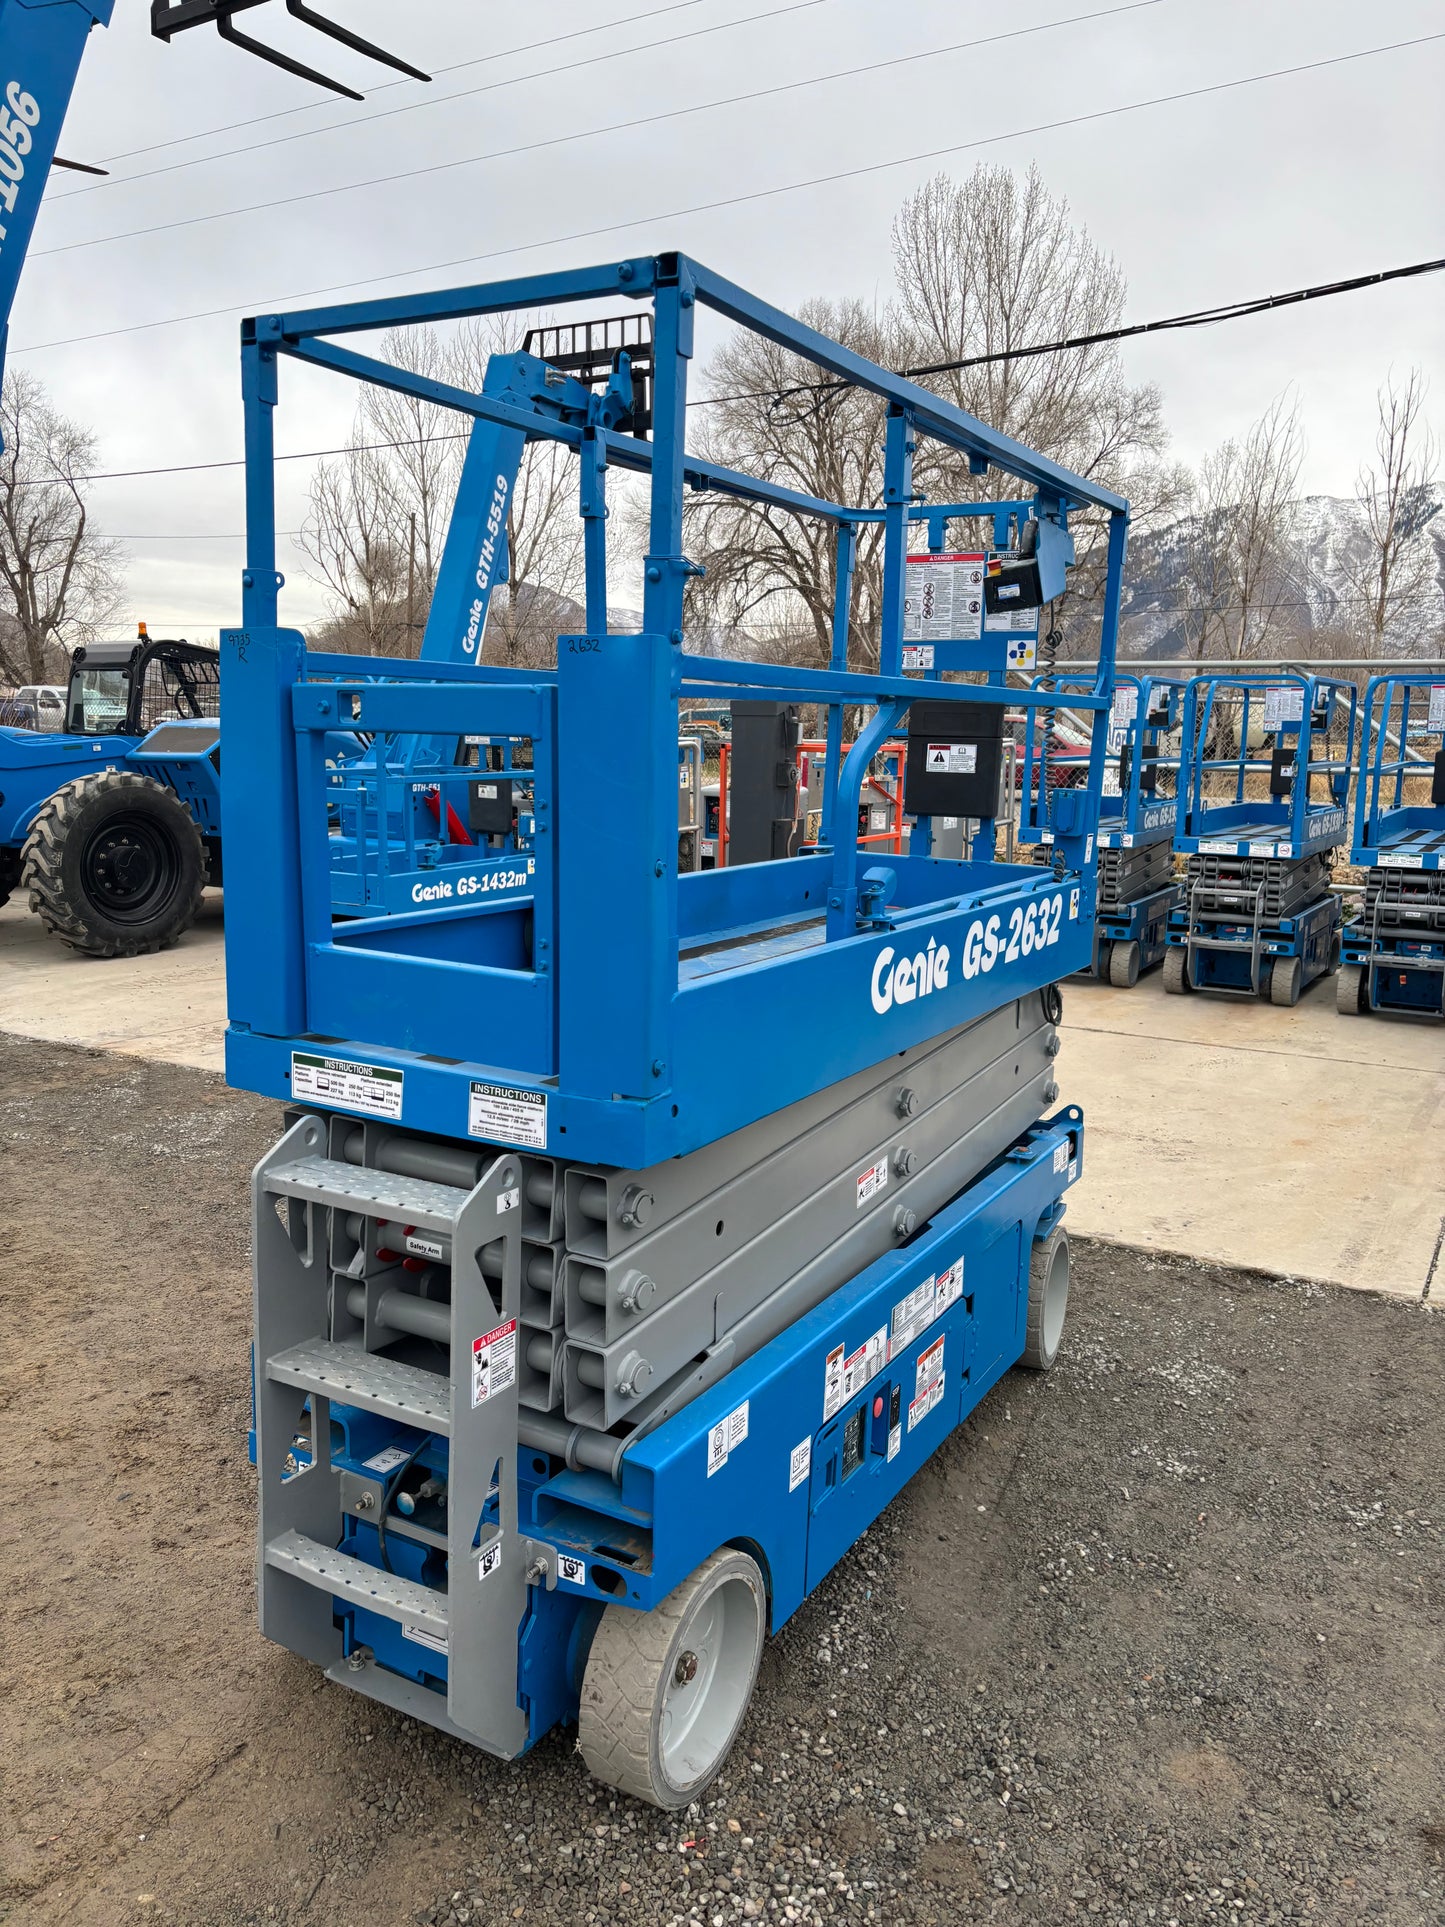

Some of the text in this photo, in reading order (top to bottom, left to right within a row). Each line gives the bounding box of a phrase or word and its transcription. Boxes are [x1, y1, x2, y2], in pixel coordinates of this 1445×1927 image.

[476, 474, 508, 589] GTH-5519
[462, 598, 484, 654] Genie
[238, 646, 248, 663] R
[567, 638, 602, 654] 2632
[412, 783, 441, 792] GTH-551
[411, 871, 527, 903] Genie GS-1432m
[871, 893, 1063, 1015] Genie GS-2632
[324, 1060, 374, 1077] INSTRUCTIONS
[474, 1083, 542, 1104] INSTRUCTIONS
[410, 1241, 440, 1255] Safety Arm
[486, 1322, 513, 1343] DANGER
